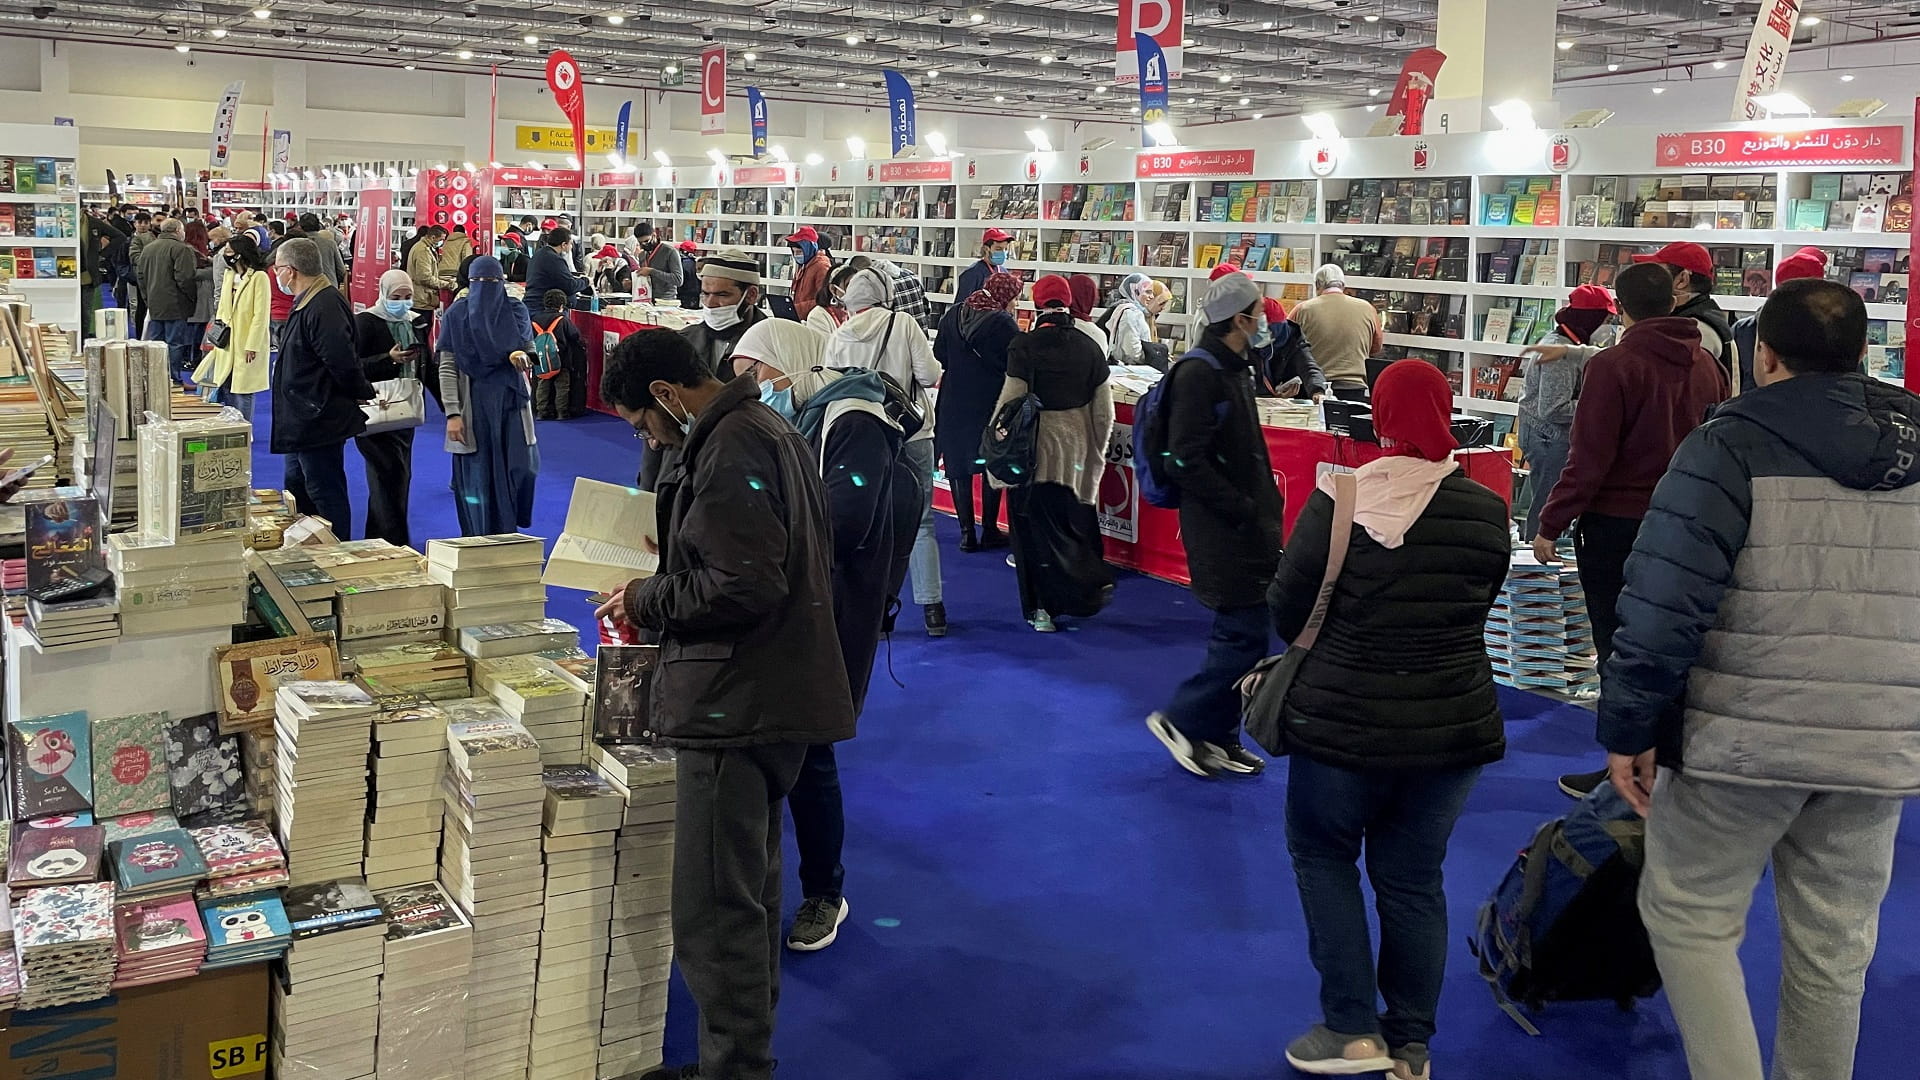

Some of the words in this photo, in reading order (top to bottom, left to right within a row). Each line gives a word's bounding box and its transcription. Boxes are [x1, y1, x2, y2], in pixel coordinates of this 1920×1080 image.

[705, 55, 721, 107] C
[549, 139, 569, 148] HALL
[1691, 138, 1726, 155] B30
[1741, 135, 1790, 154] والتوزيع
[1795, 133, 1830, 150] للنشر
[1862, 132, 1881, 148] دار
[1153, 156, 1172, 169] B30
[212, 1046, 246, 1071] SB
